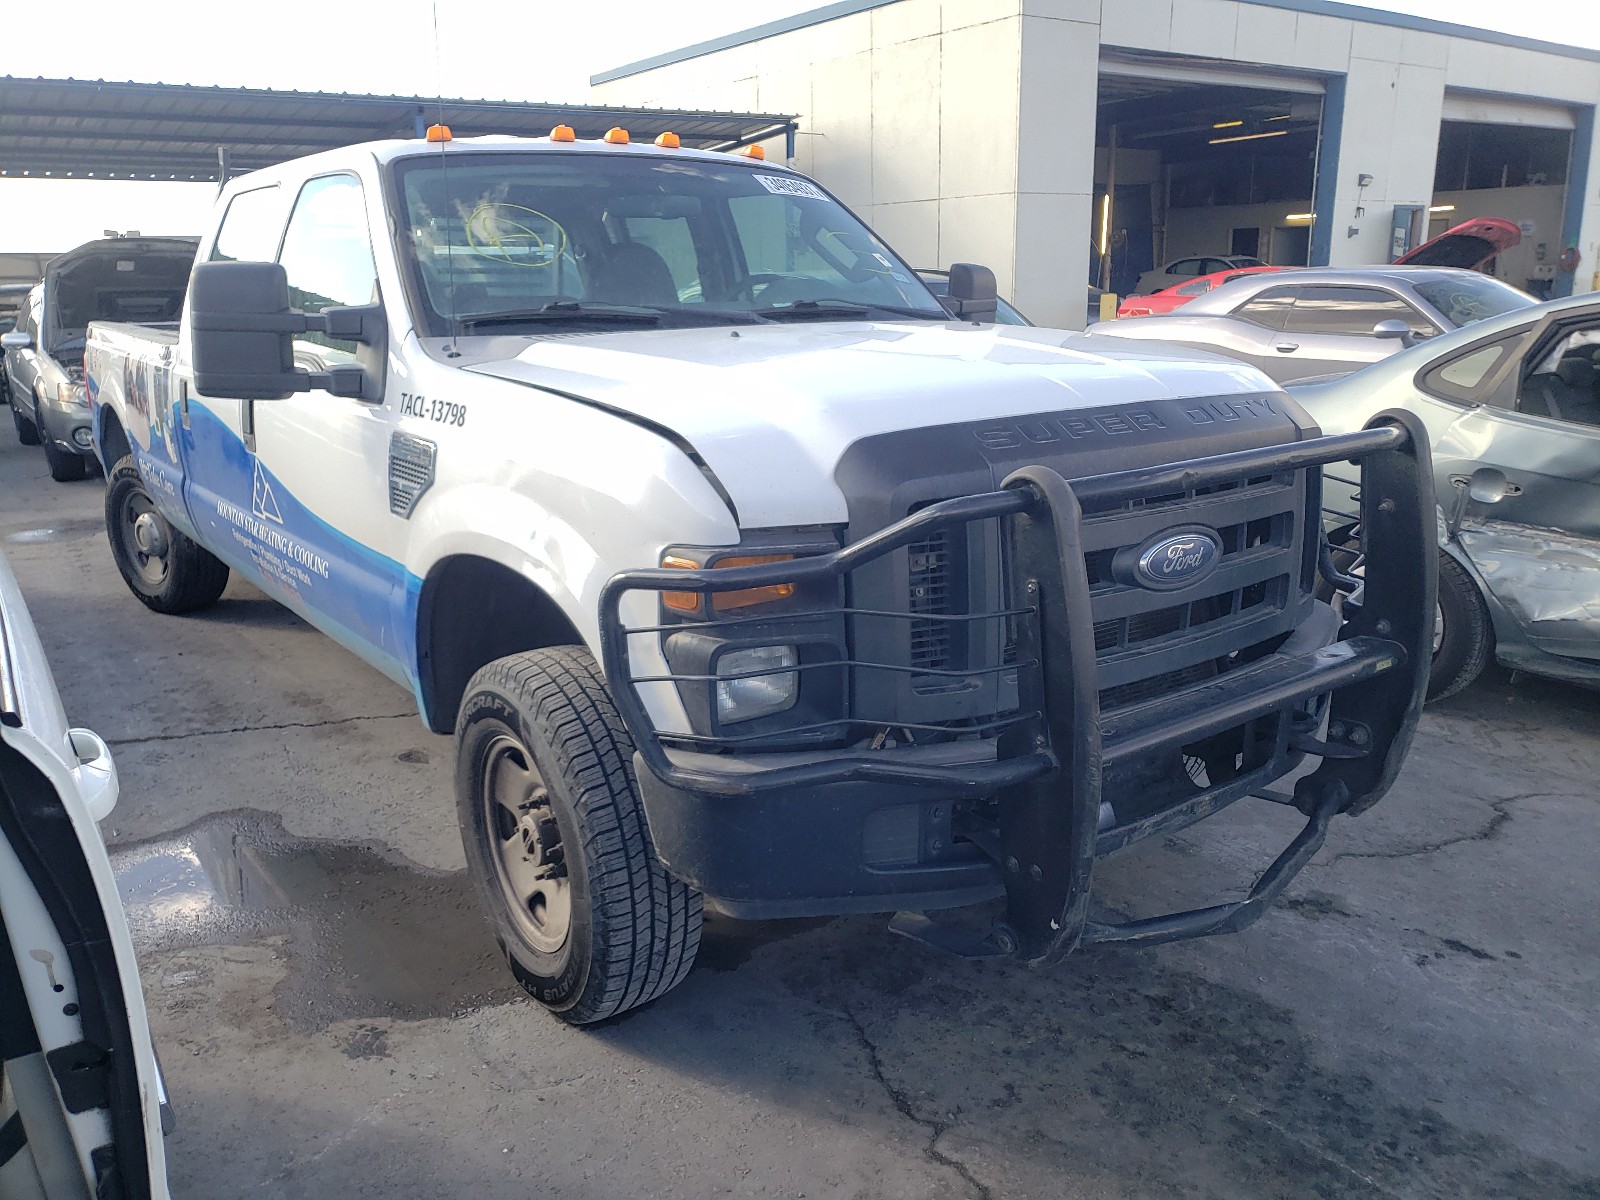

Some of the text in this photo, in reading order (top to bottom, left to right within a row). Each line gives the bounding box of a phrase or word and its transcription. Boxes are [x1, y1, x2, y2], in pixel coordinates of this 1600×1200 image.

[400, 392, 467, 427] TACL-13798
[973, 398, 1277, 450] SUPER DUTY
[217, 500, 245, 528] MOUNTAIN
[245, 516, 259, 537] STAR
[259, 523, 287, 555] HEATING
[287, 541, 294, 559] &
[294, 544, 329, 579] COOLING
[1163, 542, 1204, 574] Ford
